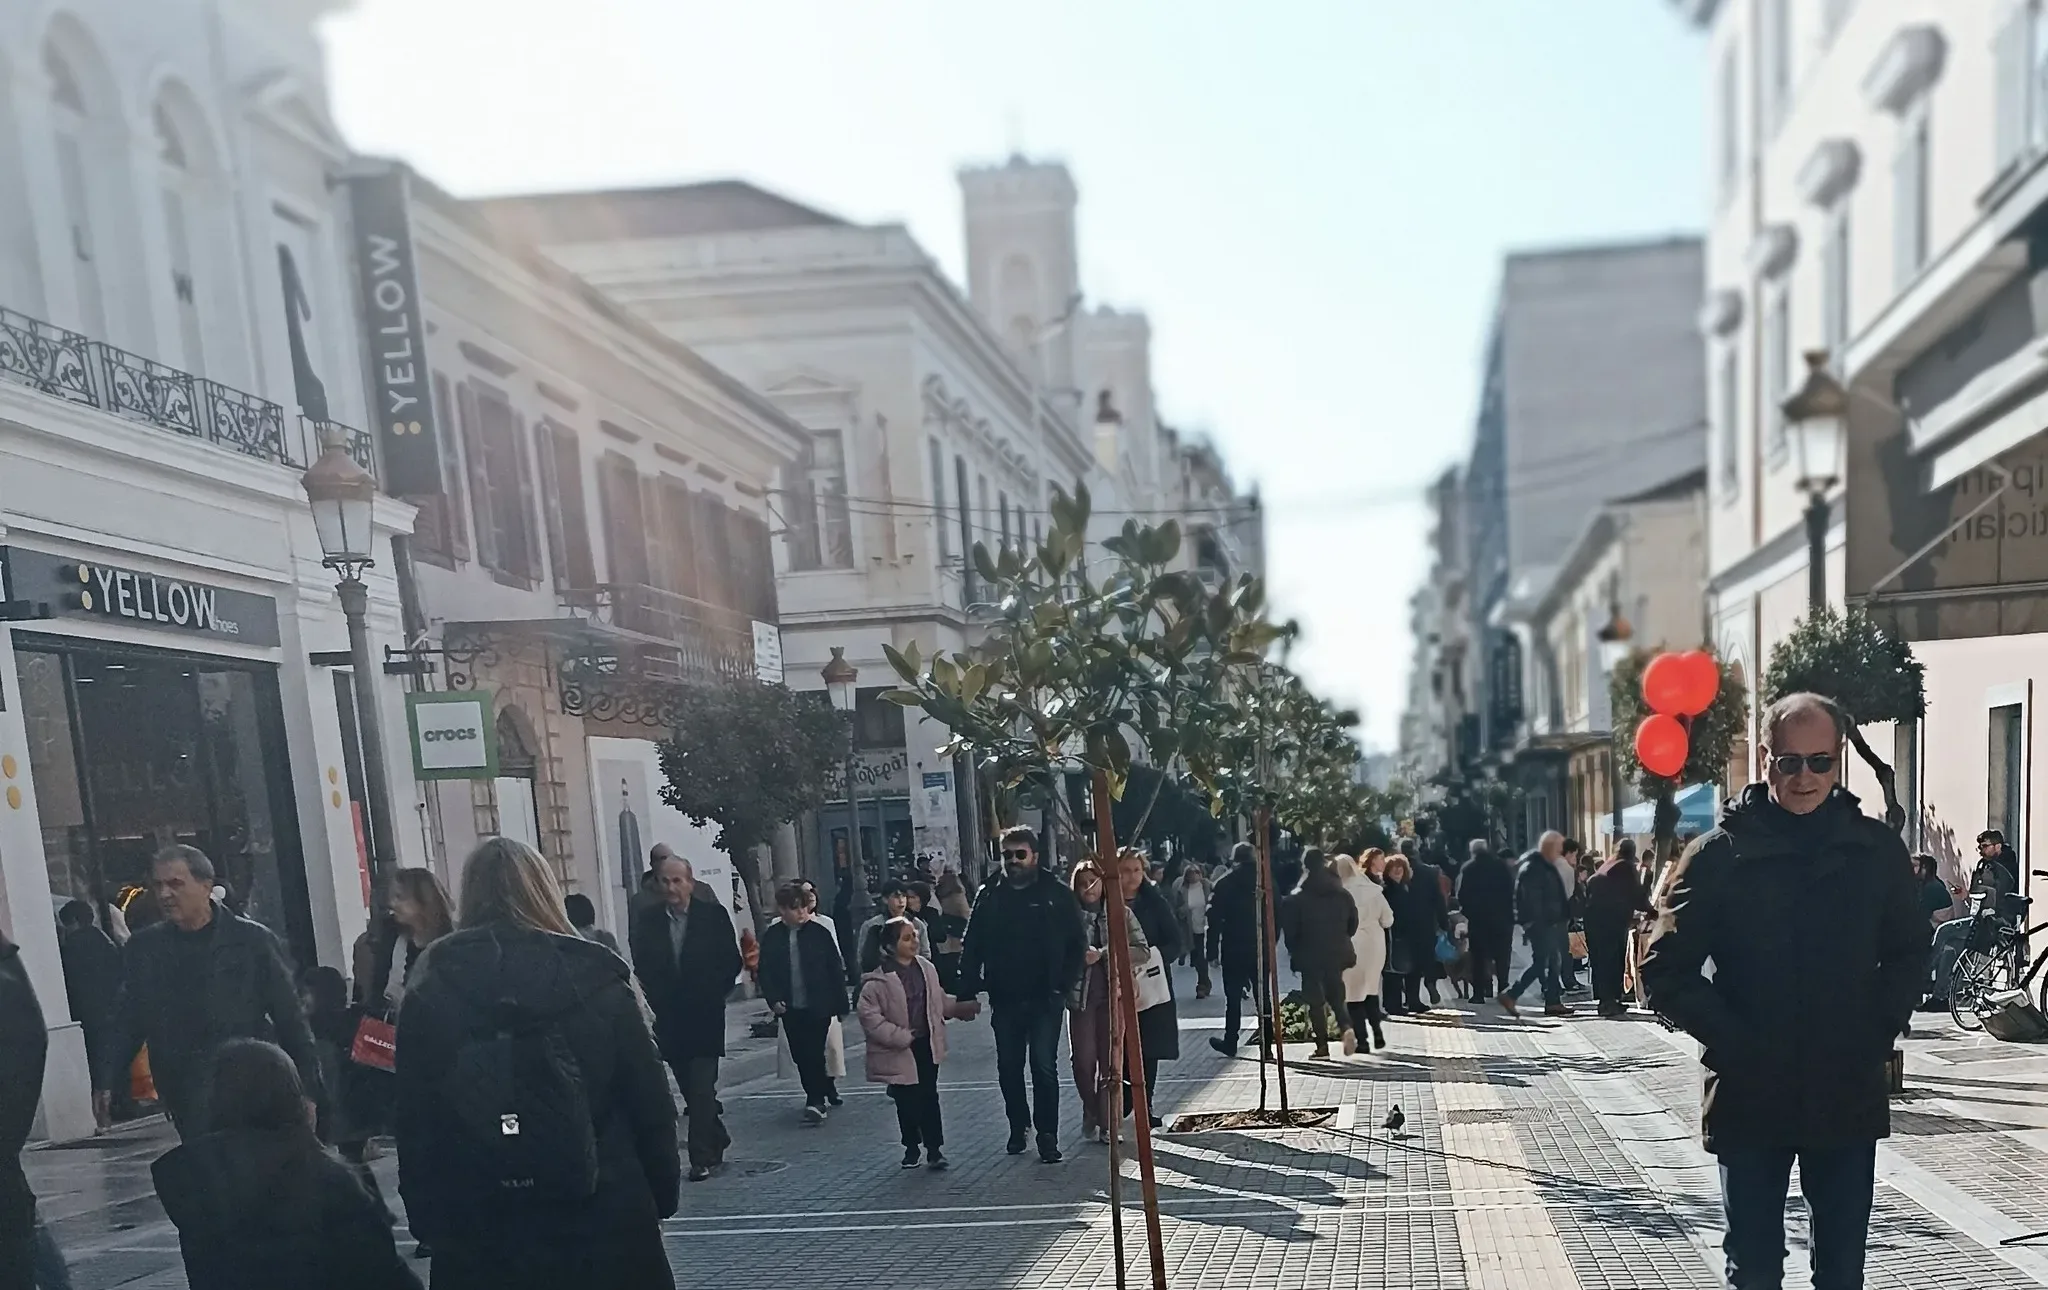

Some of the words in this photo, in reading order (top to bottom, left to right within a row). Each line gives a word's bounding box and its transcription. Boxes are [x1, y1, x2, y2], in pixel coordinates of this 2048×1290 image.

[367, 234, 418, 413] YELLOW
[94, 566, 215, 630] YELLOW
[424, 728, 477, 742] crocs
